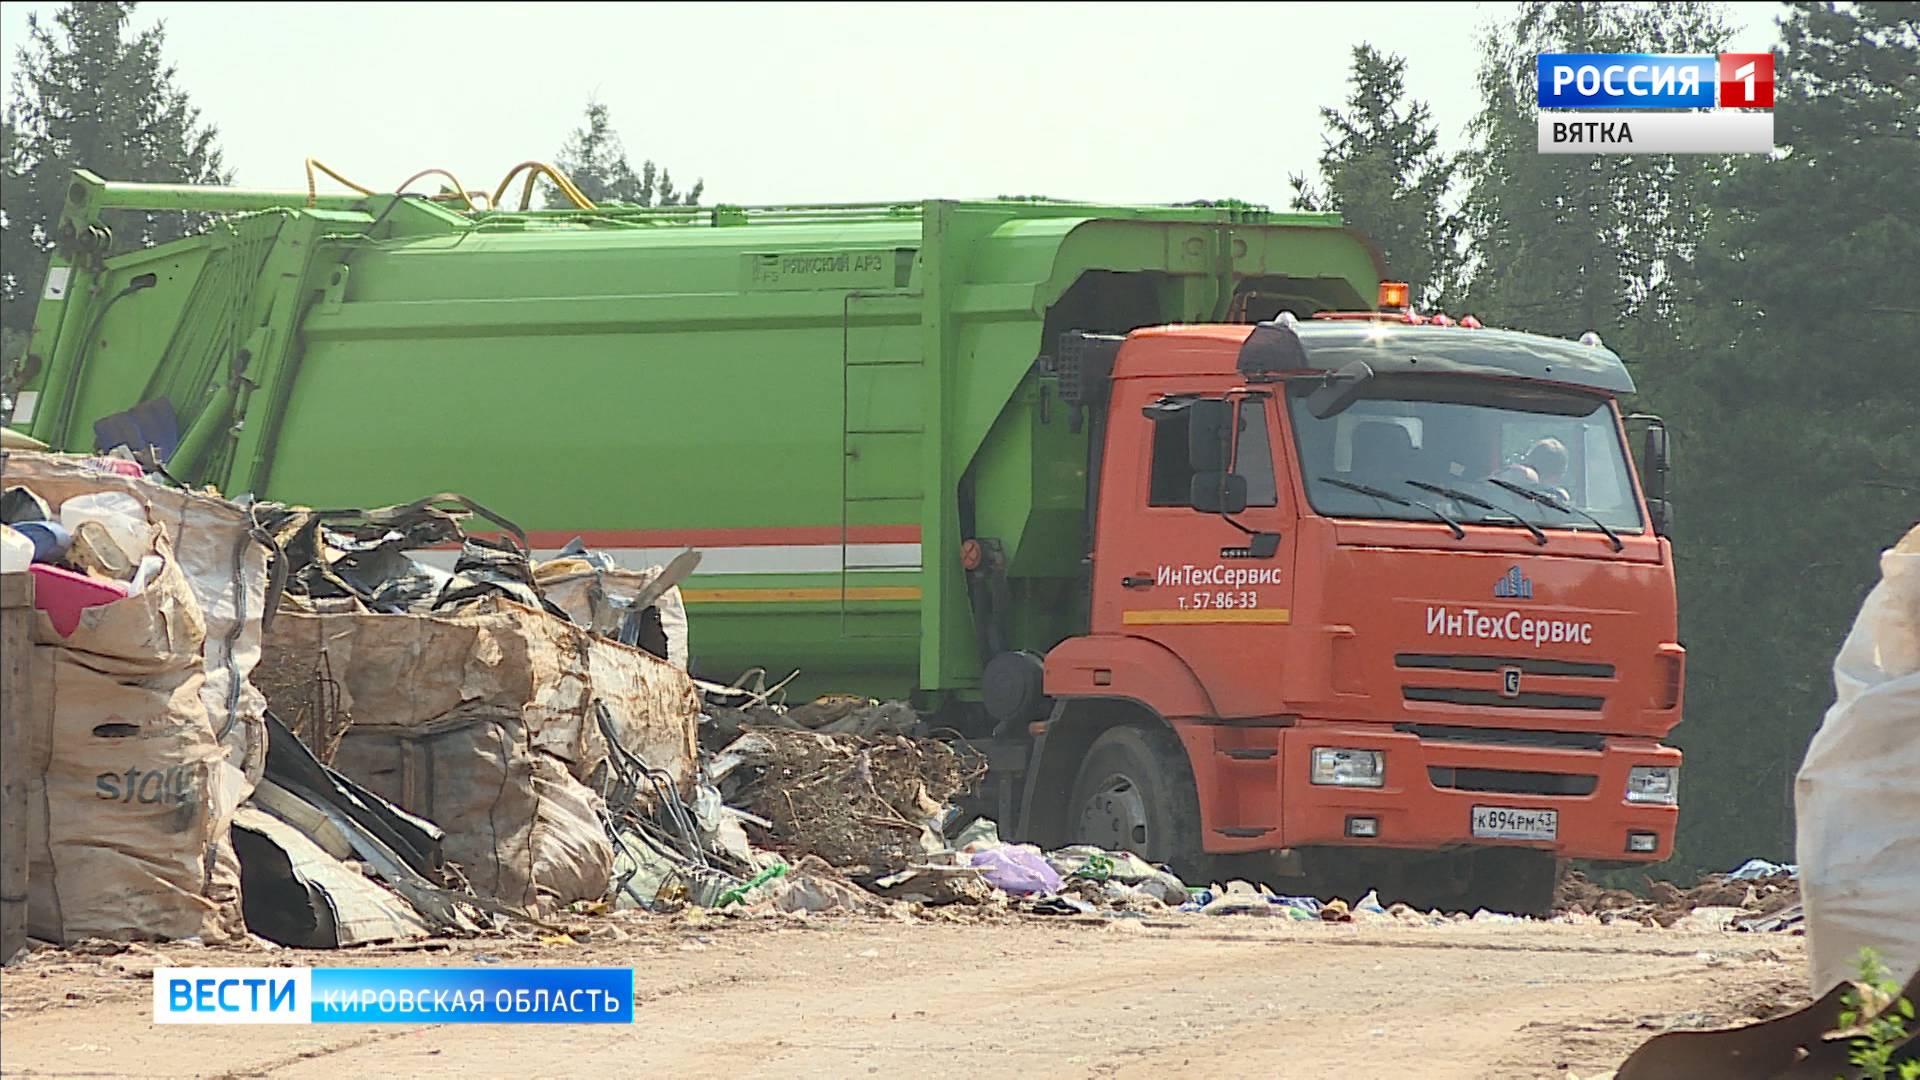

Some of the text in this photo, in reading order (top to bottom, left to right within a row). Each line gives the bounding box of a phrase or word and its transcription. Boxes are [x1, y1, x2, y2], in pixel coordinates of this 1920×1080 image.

[1157, 565, 1282, 589] ИнТехСервис
[1193, 591, 1257, 609] 57-86-33
[1426, 607, 1593, 648] ИнТехСервис
